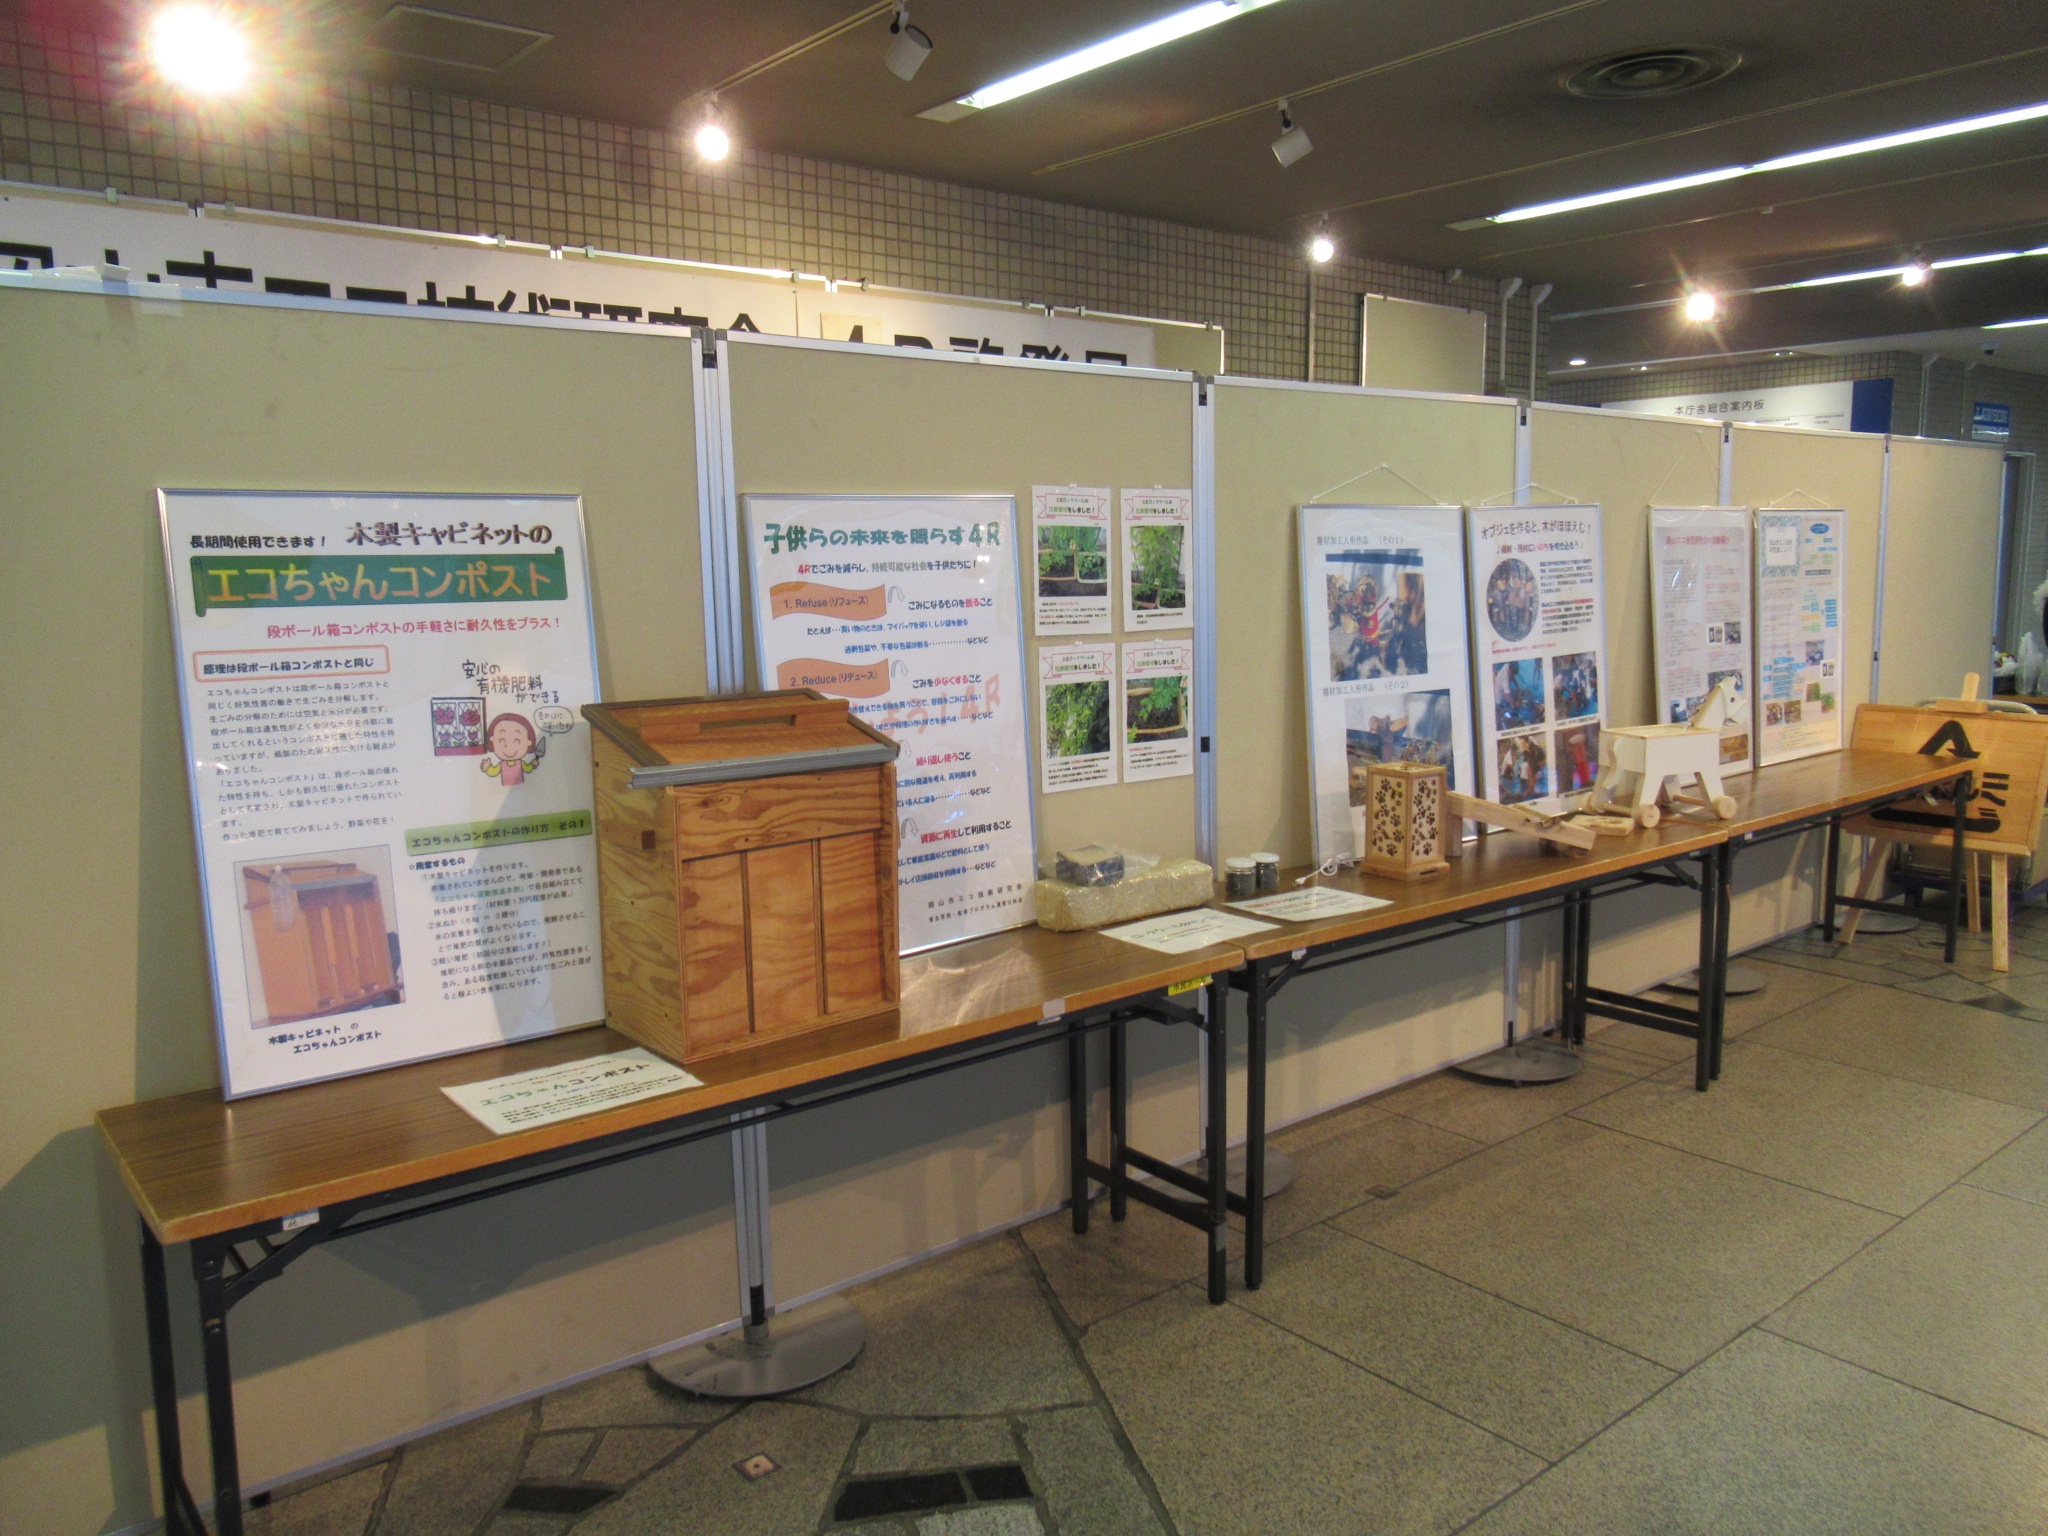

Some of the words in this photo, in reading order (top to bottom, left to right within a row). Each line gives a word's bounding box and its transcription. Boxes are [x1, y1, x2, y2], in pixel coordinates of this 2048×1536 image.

[1674, 399, 1765, 415] 本庁舎総合案内板
[190, 535, 326, 549] 長期間使用できます！
[346, 522, 552, 546] 木製キャビネットの
[764, 521, 1000, 554] 子供らの未来を照らす4R
[1481, 520, 1591, 540] オブジェを作ると、木がほほえむ！
[797, 560, 977, 574] 4Rでごみを減らし、持続可能な社会を子供たちに！
[207, 561, 550, 600] エコちゃんコンポスト
[795, 598, 828, 608] Refuse
[908, 598, 993, 611] ごみになるものを断ること
[267, 618, 560, 638] 段ボール箱コンポストの手軽さに耐久性をプラス！
[203, 658, 374, 674] 原理は段ボール箱コンポストと同じ
[462, 659, 500, 679] 安心の
[476, 674, 543, 695] 有機肥料
[802, 675, 837, 685] Reduce
[912, 674, 982, 689] ごみを少なくすること
[515, 691, 560, 703] ができる
[412, 823, 549, 847] エコちゃんコンポストの作り方
[350, 1022, 359, 1030] の
[293, 1030, 383, 1054] エコちゃんコンポスト
